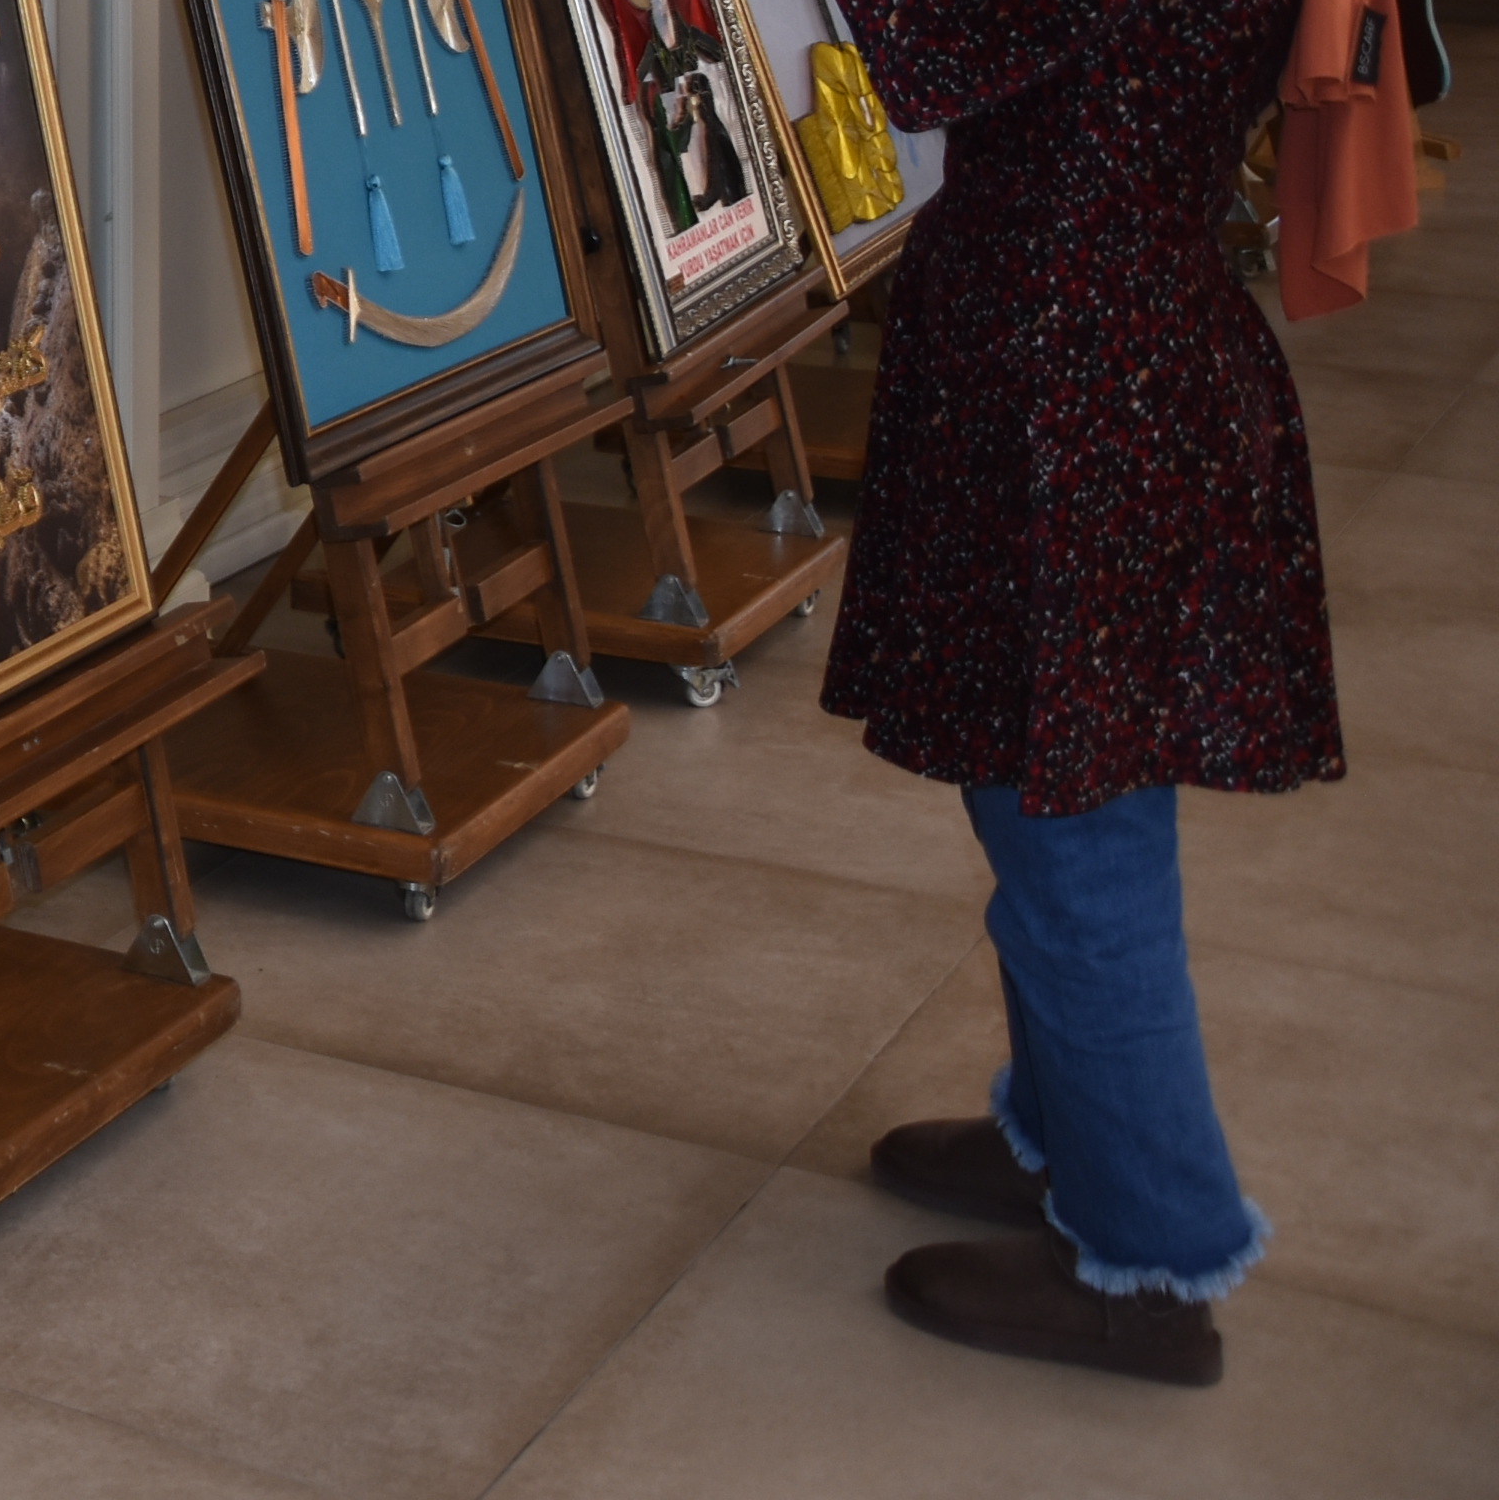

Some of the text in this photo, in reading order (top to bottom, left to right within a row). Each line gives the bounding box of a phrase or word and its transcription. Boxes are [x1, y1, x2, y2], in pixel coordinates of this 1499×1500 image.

[666, 218, 720, 261] KAHRAMANLAR
[718, 208, 735, 230] CAN
[678, 253, 705, 278] YURDU
[703, 232, 741, 265] YAŞATMAK
